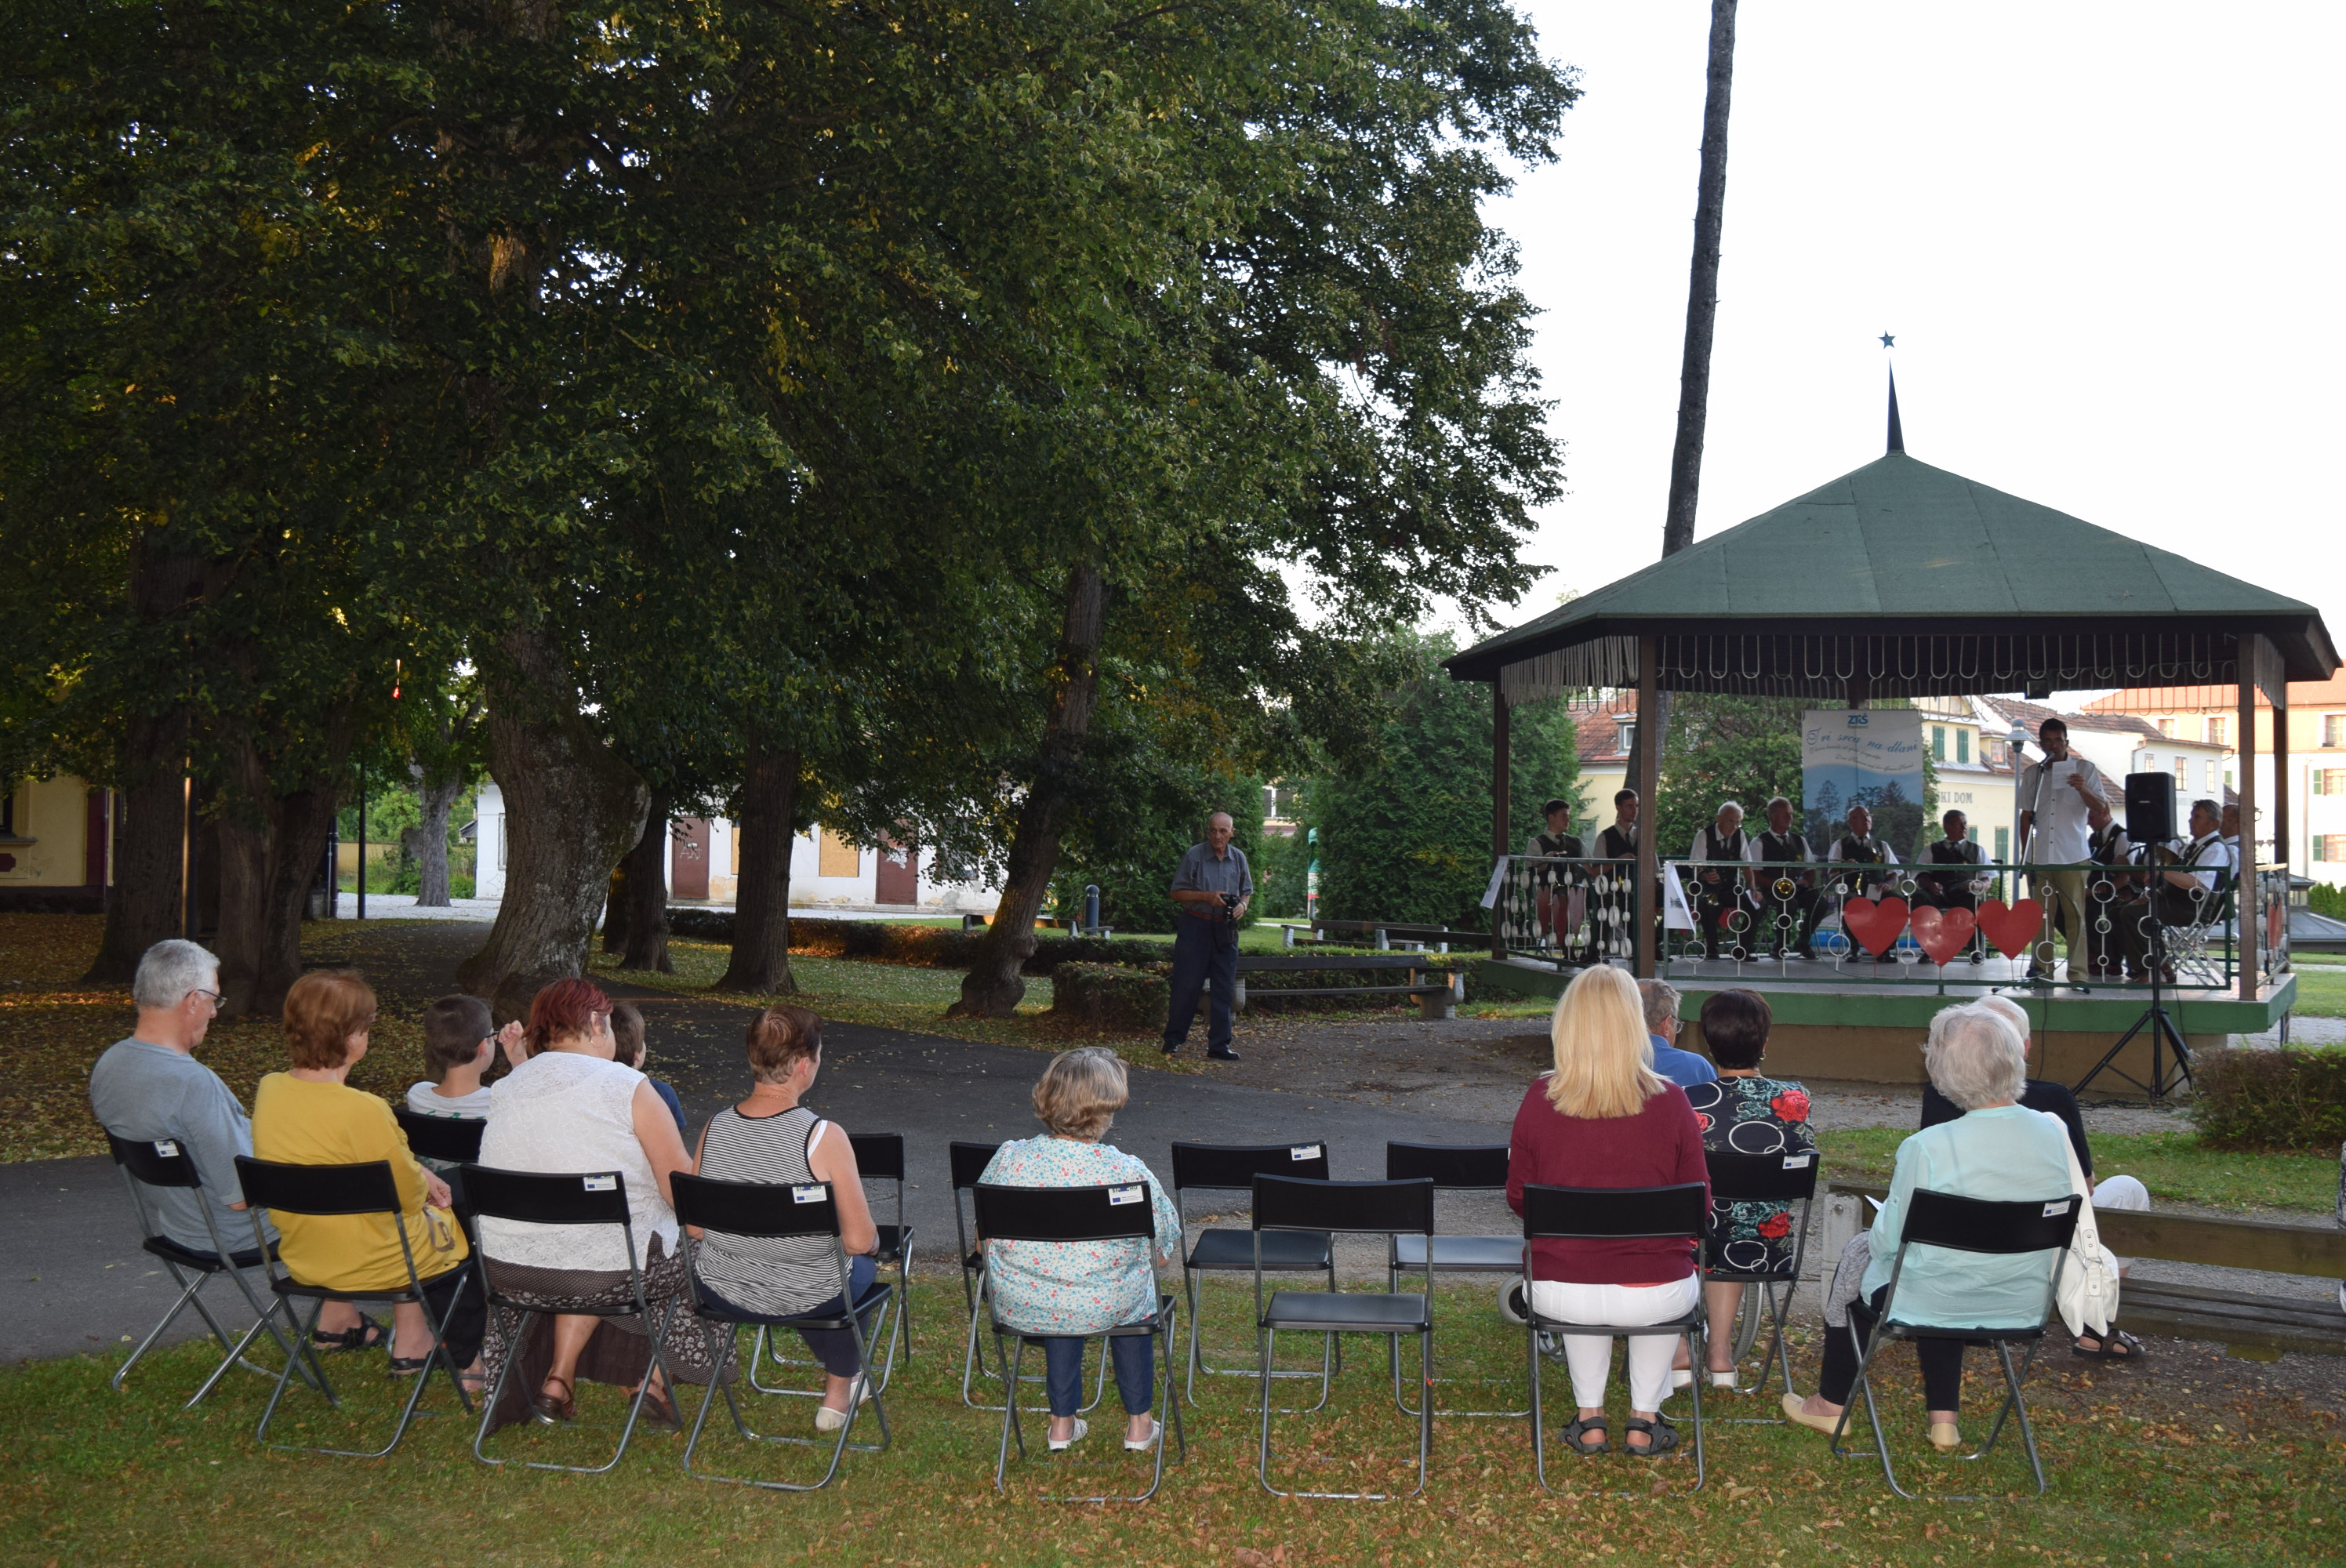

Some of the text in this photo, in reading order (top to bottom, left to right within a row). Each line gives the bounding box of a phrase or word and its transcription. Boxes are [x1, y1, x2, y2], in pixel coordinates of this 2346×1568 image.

[1806, 727, 1832, 745] Tri
[1867, 740, 1883, 750] na
[1887, 739, 1918, 753] dlani
[1954, 792, 1973, 804] DOM
